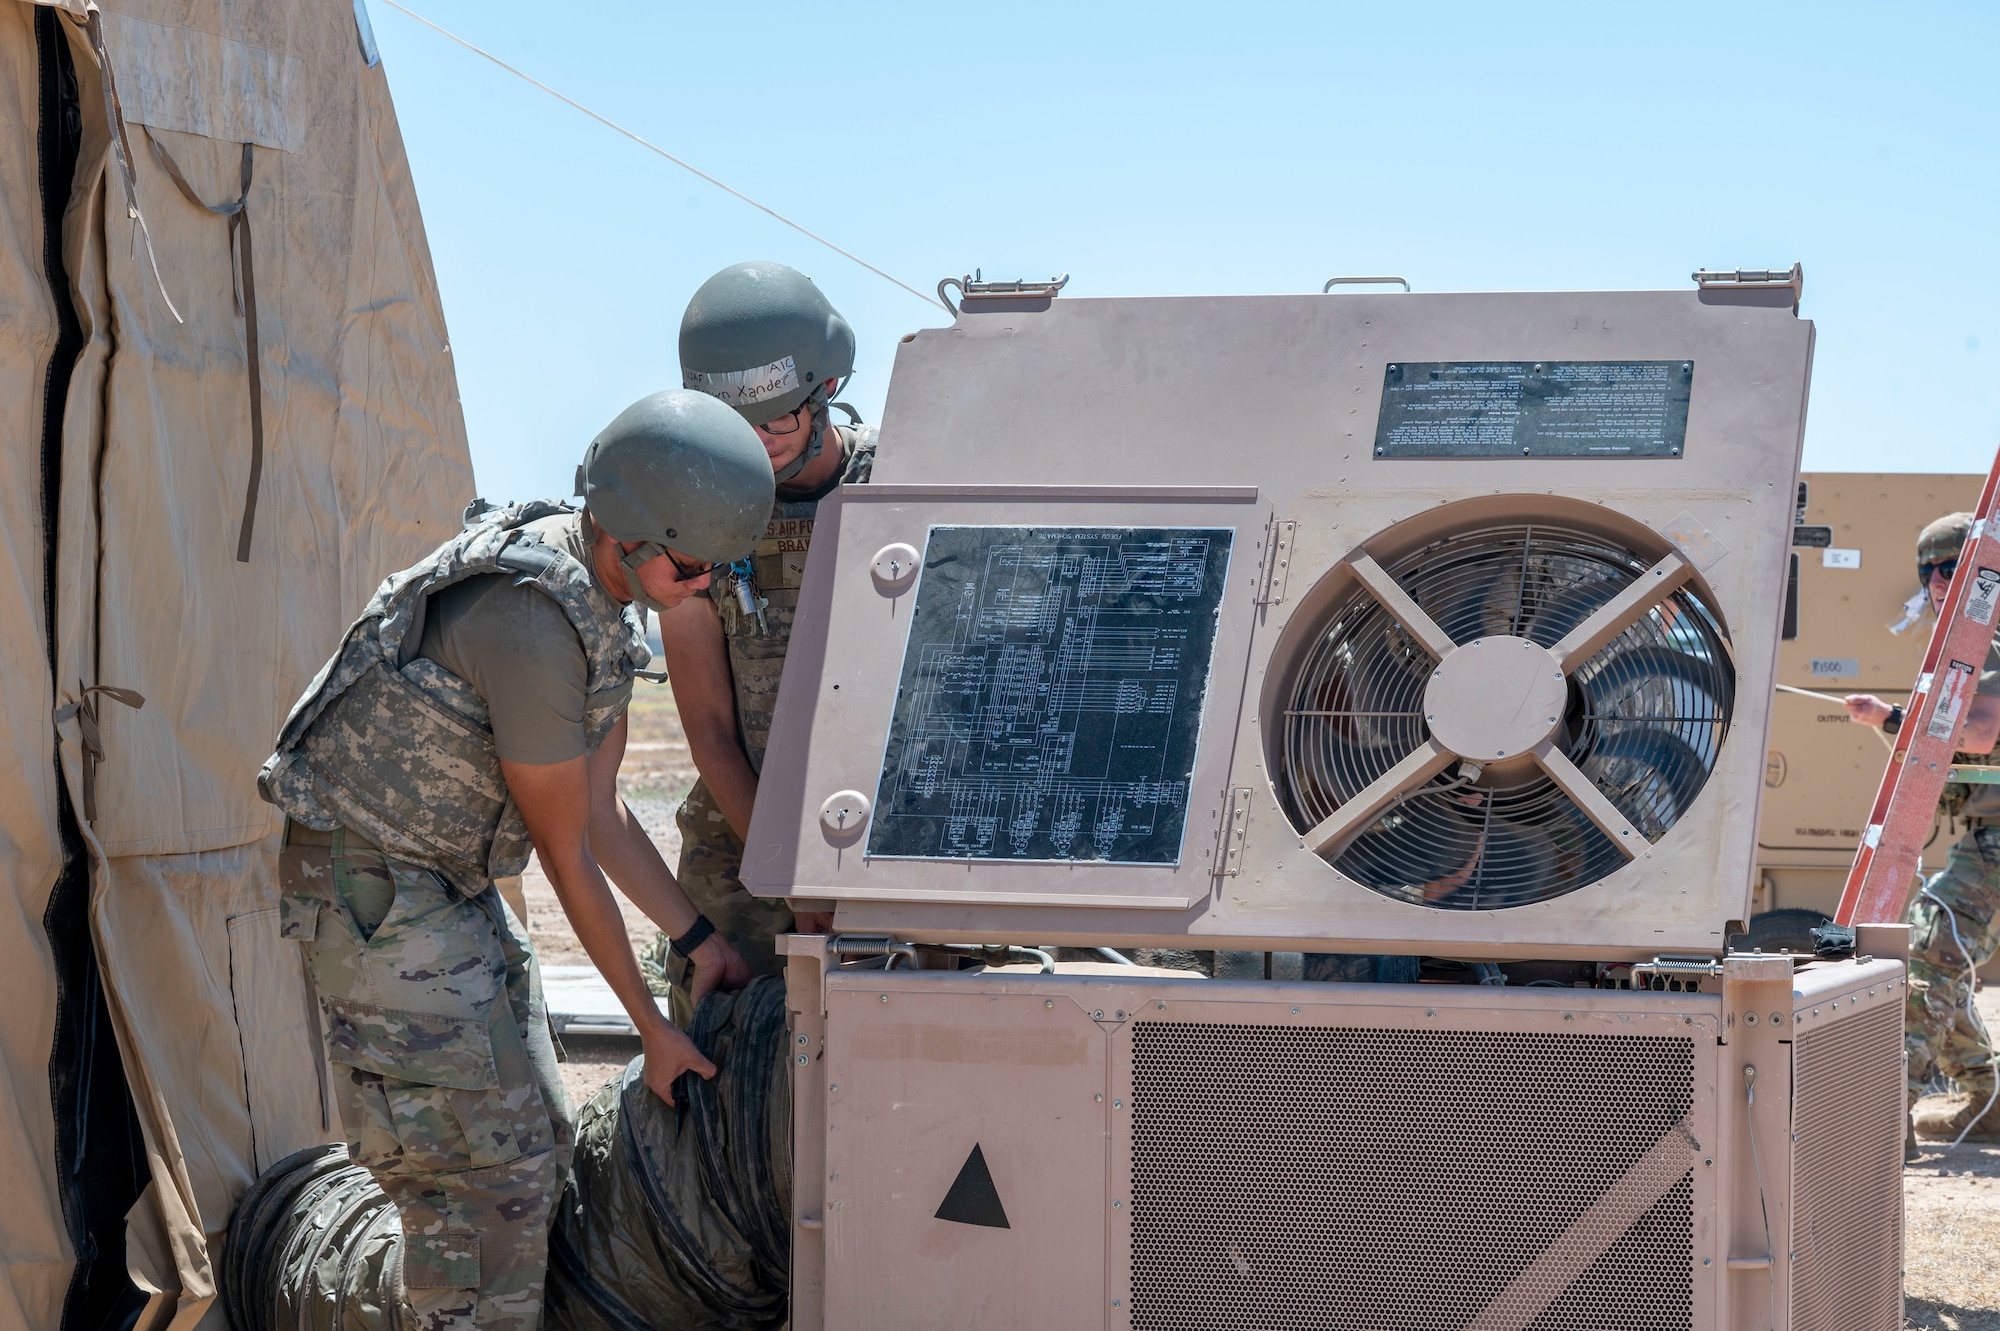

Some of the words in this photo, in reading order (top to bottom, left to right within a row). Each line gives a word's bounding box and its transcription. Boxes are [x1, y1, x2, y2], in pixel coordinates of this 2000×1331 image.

[769, 358, 794, 374] A1C
[737, 374, 789, 398] Xander
[778, 521, 797, 536] AIR
[777, 539, 811, 552] BRA
[1817, 714, 1850, 723] OUTPUT
